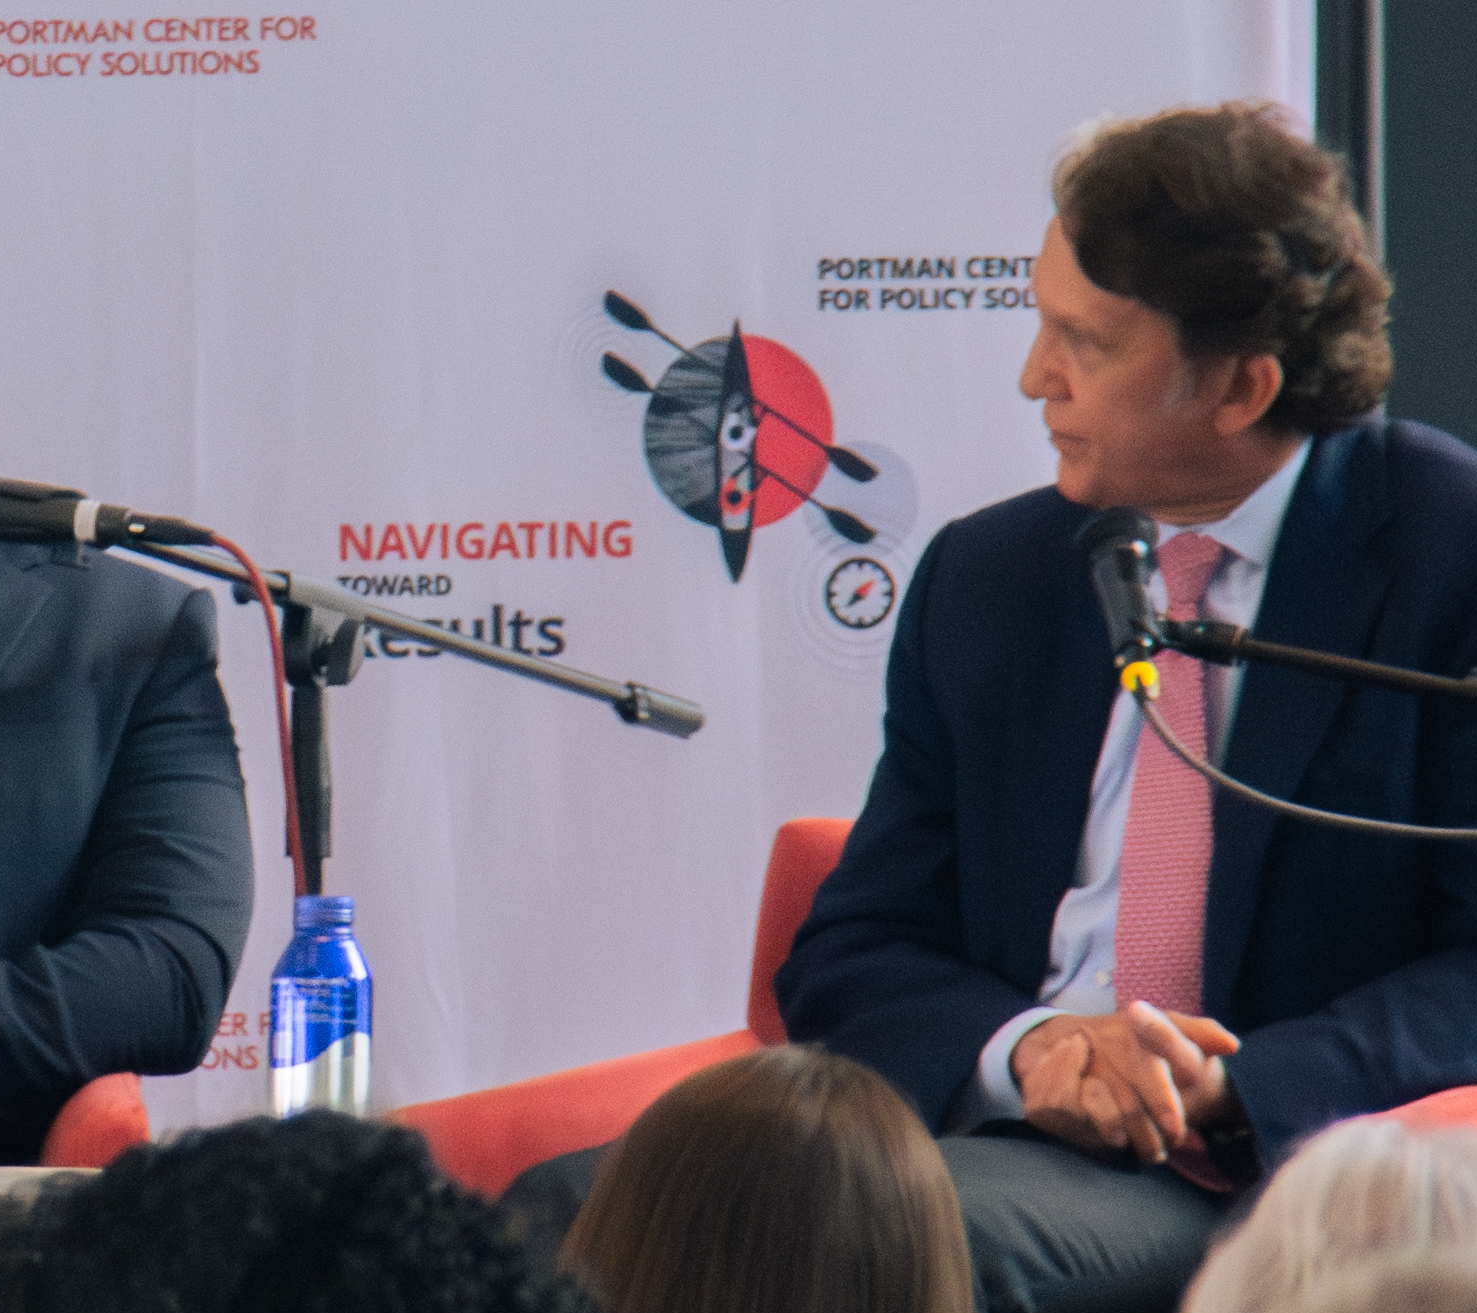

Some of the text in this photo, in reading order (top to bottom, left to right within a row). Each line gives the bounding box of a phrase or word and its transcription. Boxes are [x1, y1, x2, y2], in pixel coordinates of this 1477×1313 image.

[143, 17, 250, 43] CENTER
[260, 16, 316, 41] FOR
[100, 49, 261, 76] SOLUTIONS
[817, 255, 1036, 281] PORTMAN CENT
[817, 287, 870, 312] FOR
[879, 287, 976, 311] POLICY
[339, 519, 634, 562] NAVIGATING
